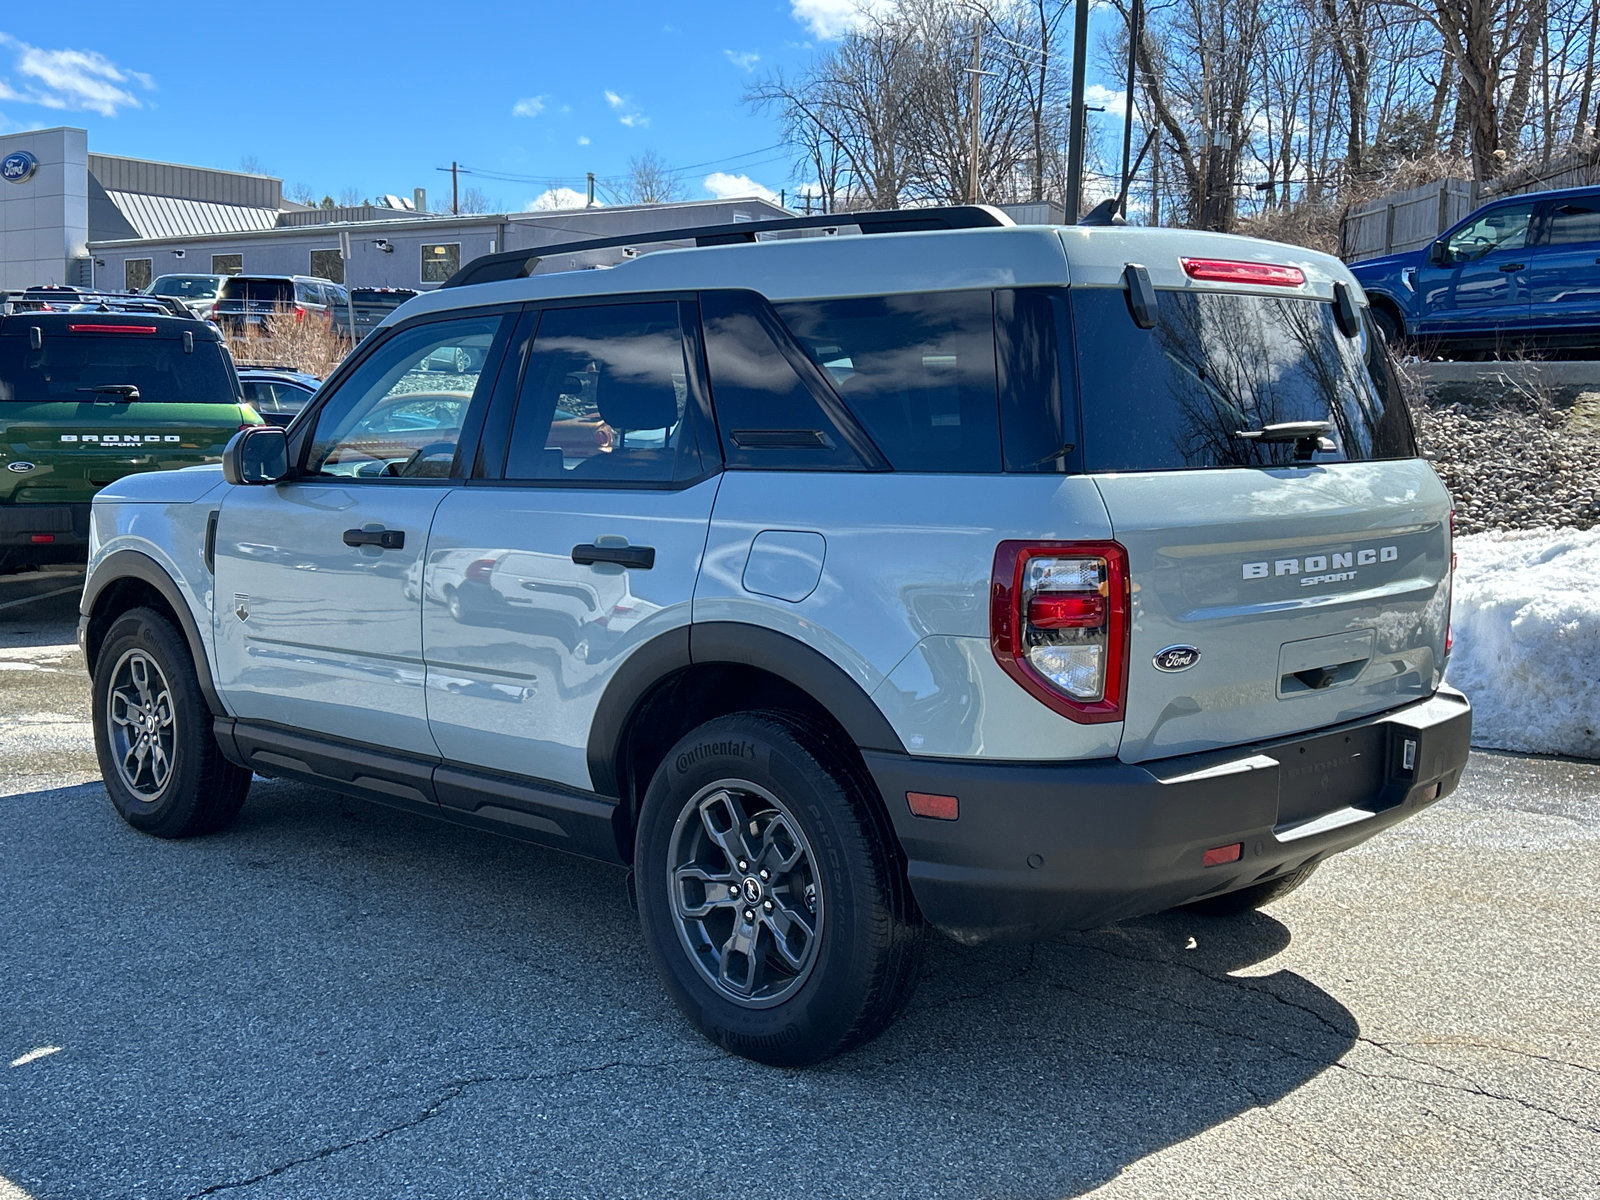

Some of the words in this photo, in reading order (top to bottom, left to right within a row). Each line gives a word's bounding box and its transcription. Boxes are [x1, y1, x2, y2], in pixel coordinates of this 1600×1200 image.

[4, 158, 24, 176] Ford
[60, 434, 181, 442] BRONCO
[1242, 546, 1398, 580] BRONCO
[1300, 571, 1357, 587] SPORT
[1166, 650, 1193, 667] Ford
[676, 739, 746, 774] Continental
